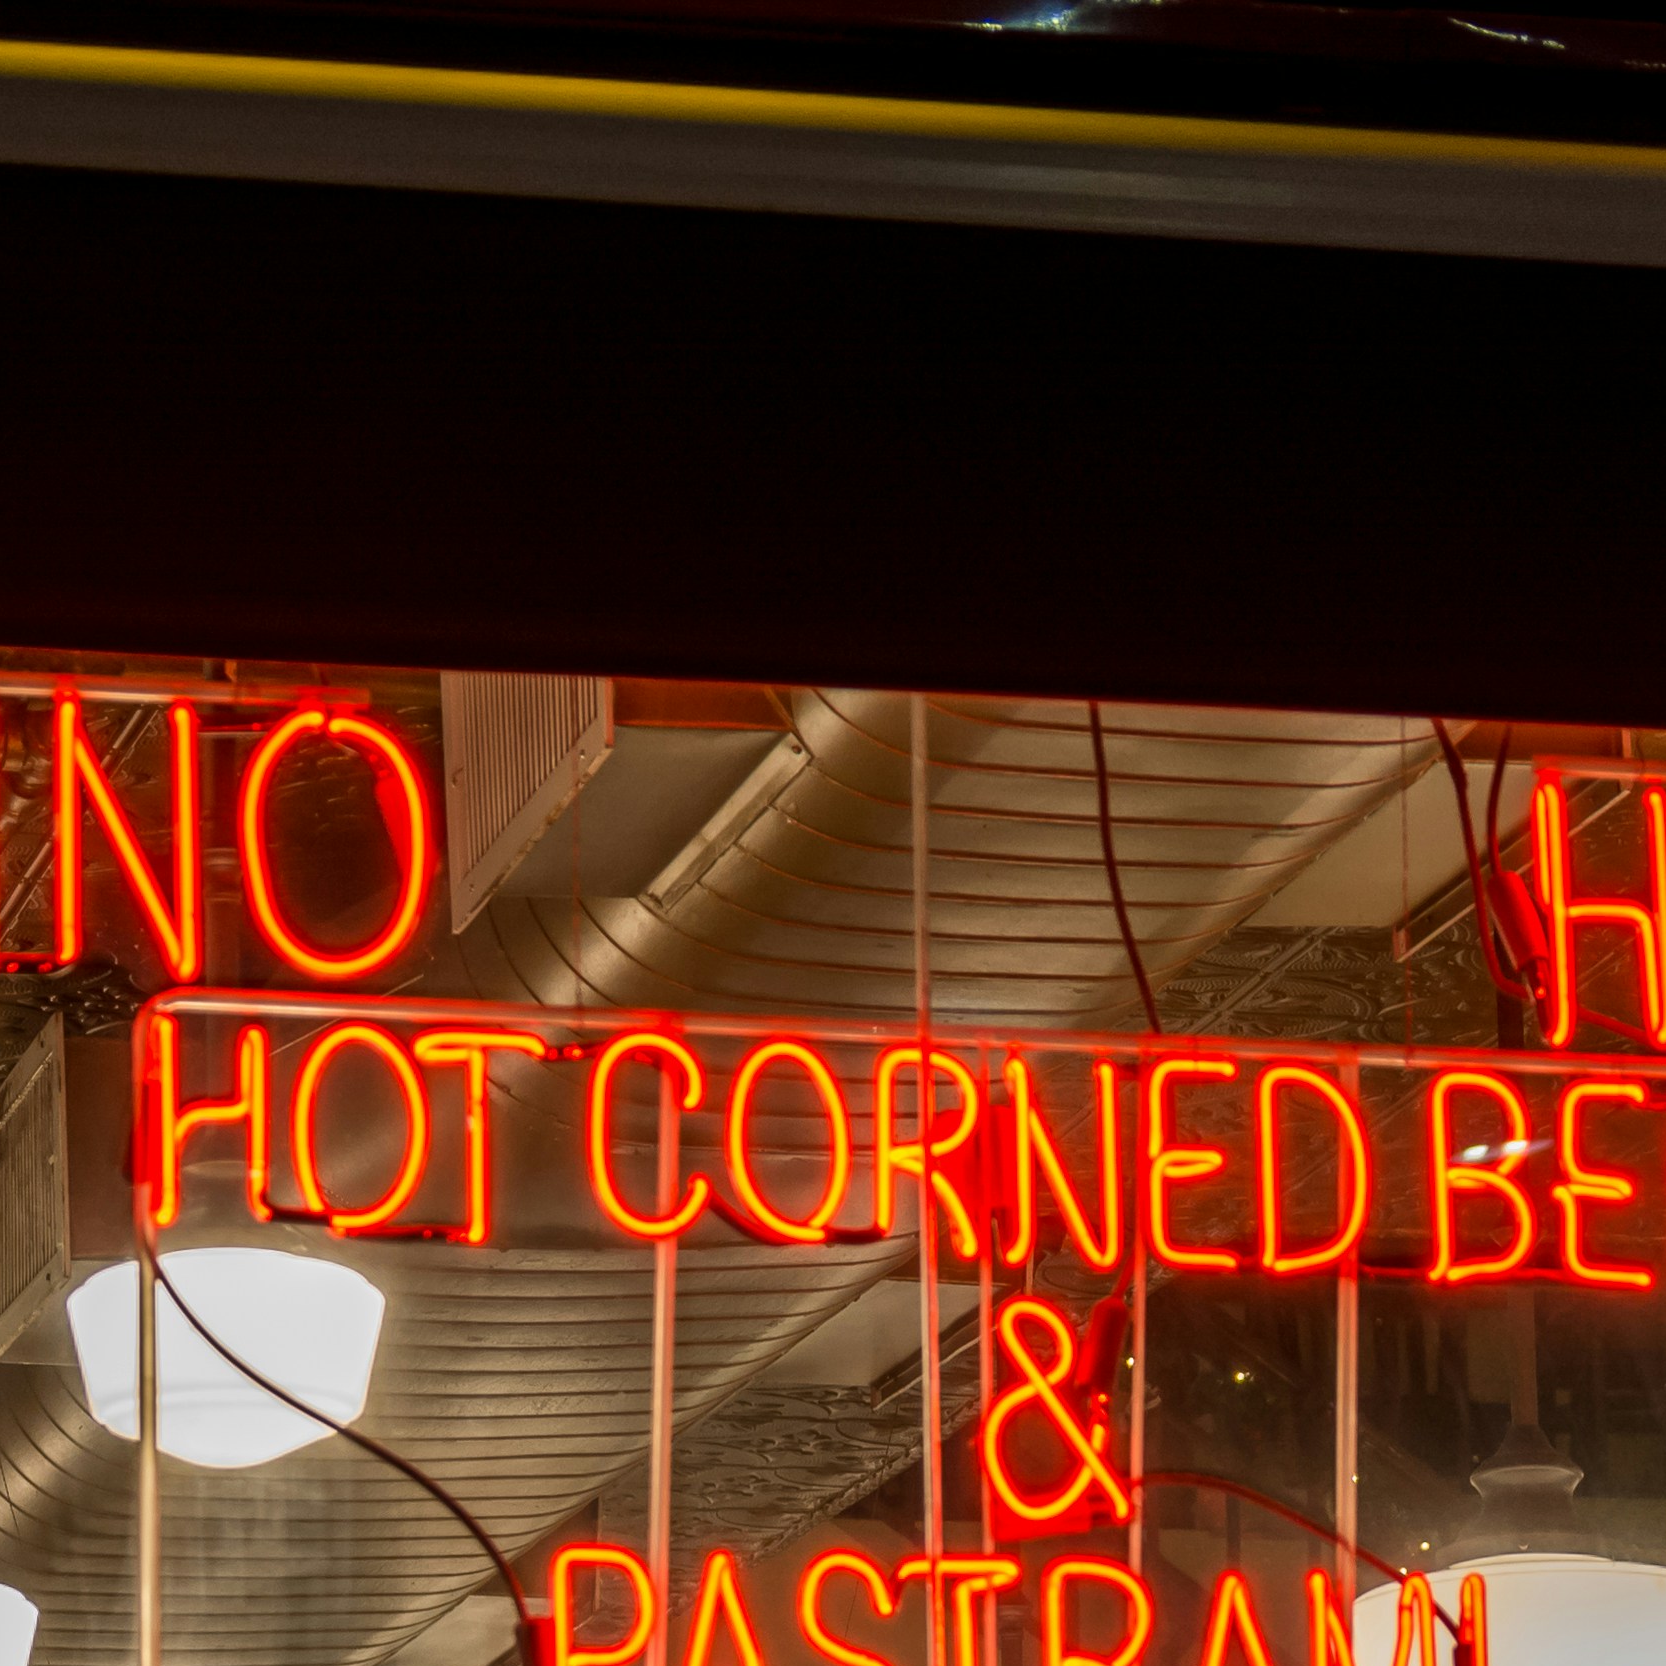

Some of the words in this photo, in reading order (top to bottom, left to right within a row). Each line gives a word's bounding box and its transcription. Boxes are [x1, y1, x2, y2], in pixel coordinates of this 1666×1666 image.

[150, 1012, 548, 1247] HOT
[588, 1028, 1371, 1278] CORNED
[980, 1294, 1132, 1525] &
